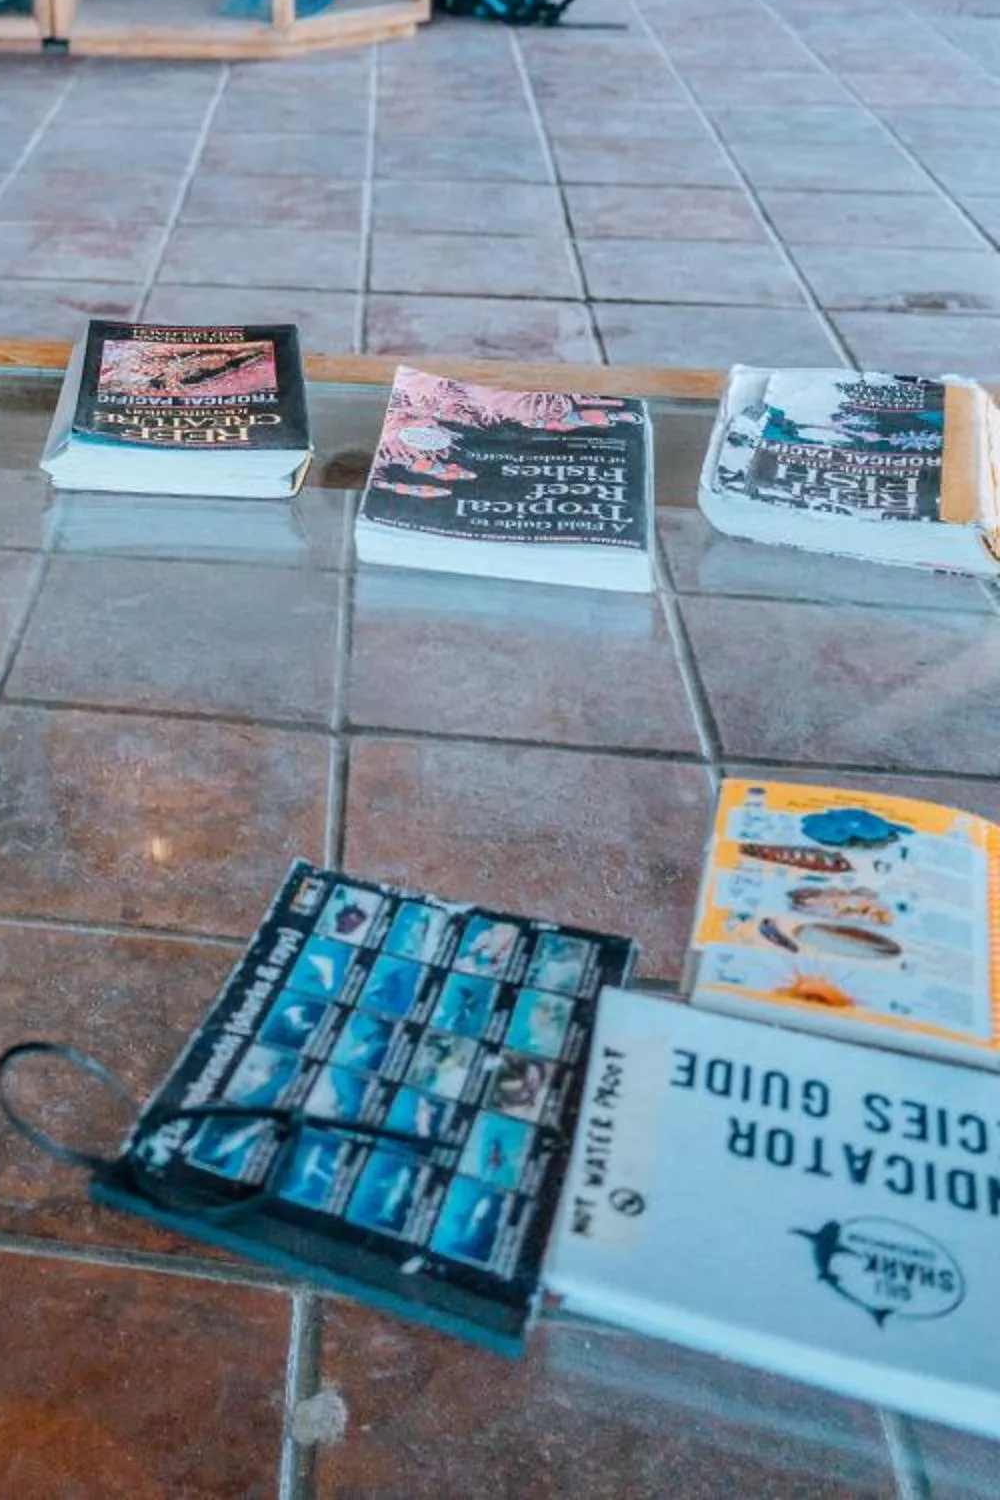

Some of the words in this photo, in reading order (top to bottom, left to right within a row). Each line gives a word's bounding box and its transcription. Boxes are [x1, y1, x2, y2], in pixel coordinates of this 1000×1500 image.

[96, 393, 174, 405] PACIFIC
[179, 393, 279, 406] TROPICAL
[92, 410, 282, 428] CREATURE
[119, 427, 250, 443] REEF
[753, 440, 833, 459] PACIFI
[843, 452, 941, 467] ROPICAL
[500, 464, 628, 484] Fishes
[775, 463, 920, 493] FISH
[524, 483, 627, 503] Reef
[455, 497, 634, 524] Tropical
[469, 517, 490, 528] to
[493, 518, 552, 531] Guide
[556, 520, 606, 532] Field
[611, 522, 628, 532] A
[669, 1048, 831, 1120] GUIDE
[862, 1092, 1000, 1156] CIES
[582, 1117, 615, 1188] WATER
[863, 1252, 956, 1293] SHARK
